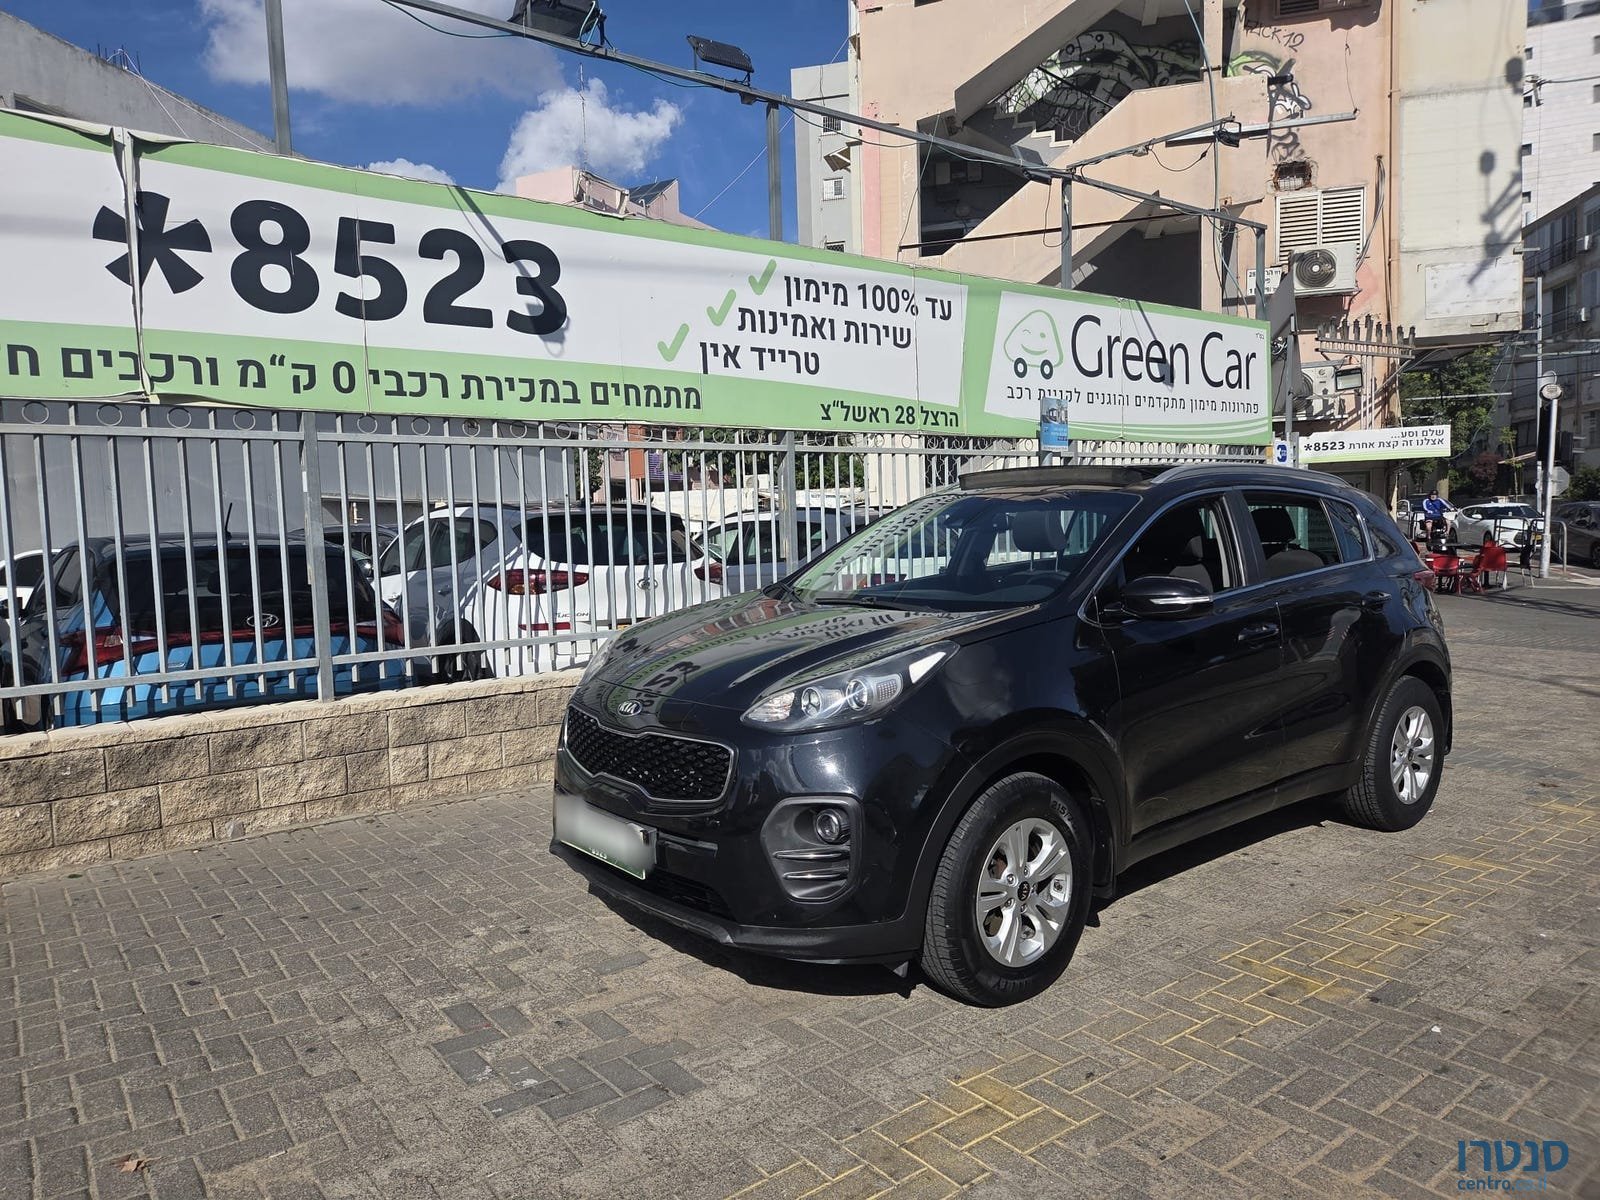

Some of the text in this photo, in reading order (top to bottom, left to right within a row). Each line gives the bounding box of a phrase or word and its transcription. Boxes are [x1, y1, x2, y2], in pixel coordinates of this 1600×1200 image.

[784, 275, 952, 321] עד 100% מימון
[738, 306, 912, 349] שירות ואמינות
[700, 341, 820, 375] טרייד אין
[1071, 314, 1256, 390] Green Car
[61, 347, 219, 386] ורכבים
[332, 361, 356, 394] 0
[368, 369, 449, 398] רכבי
[461, 374, 581, 404] במכירת
[590, 381, 702, 410] מתמחים
[1007, 386, 1032, 400] רכב
[1087, 392, 1129, 406] והוגנים
[1135, 395, 1186, 412] מתקדמים
[1190, 399, 1217, 413] מימון
[1221, 401, 1259, 414] פתרונות
[895, 405, 915, 424] 28
[920, 405, 959, 427] הרצל
[1416, 437, 1444, 446] אצלנו
[1421, 428, 1444, 437] שלם
[1348, 441, 1375, 450] אחרת
[1378, 440, 1398, 449] קצת
[1402, 439, 1413, 447] זה
